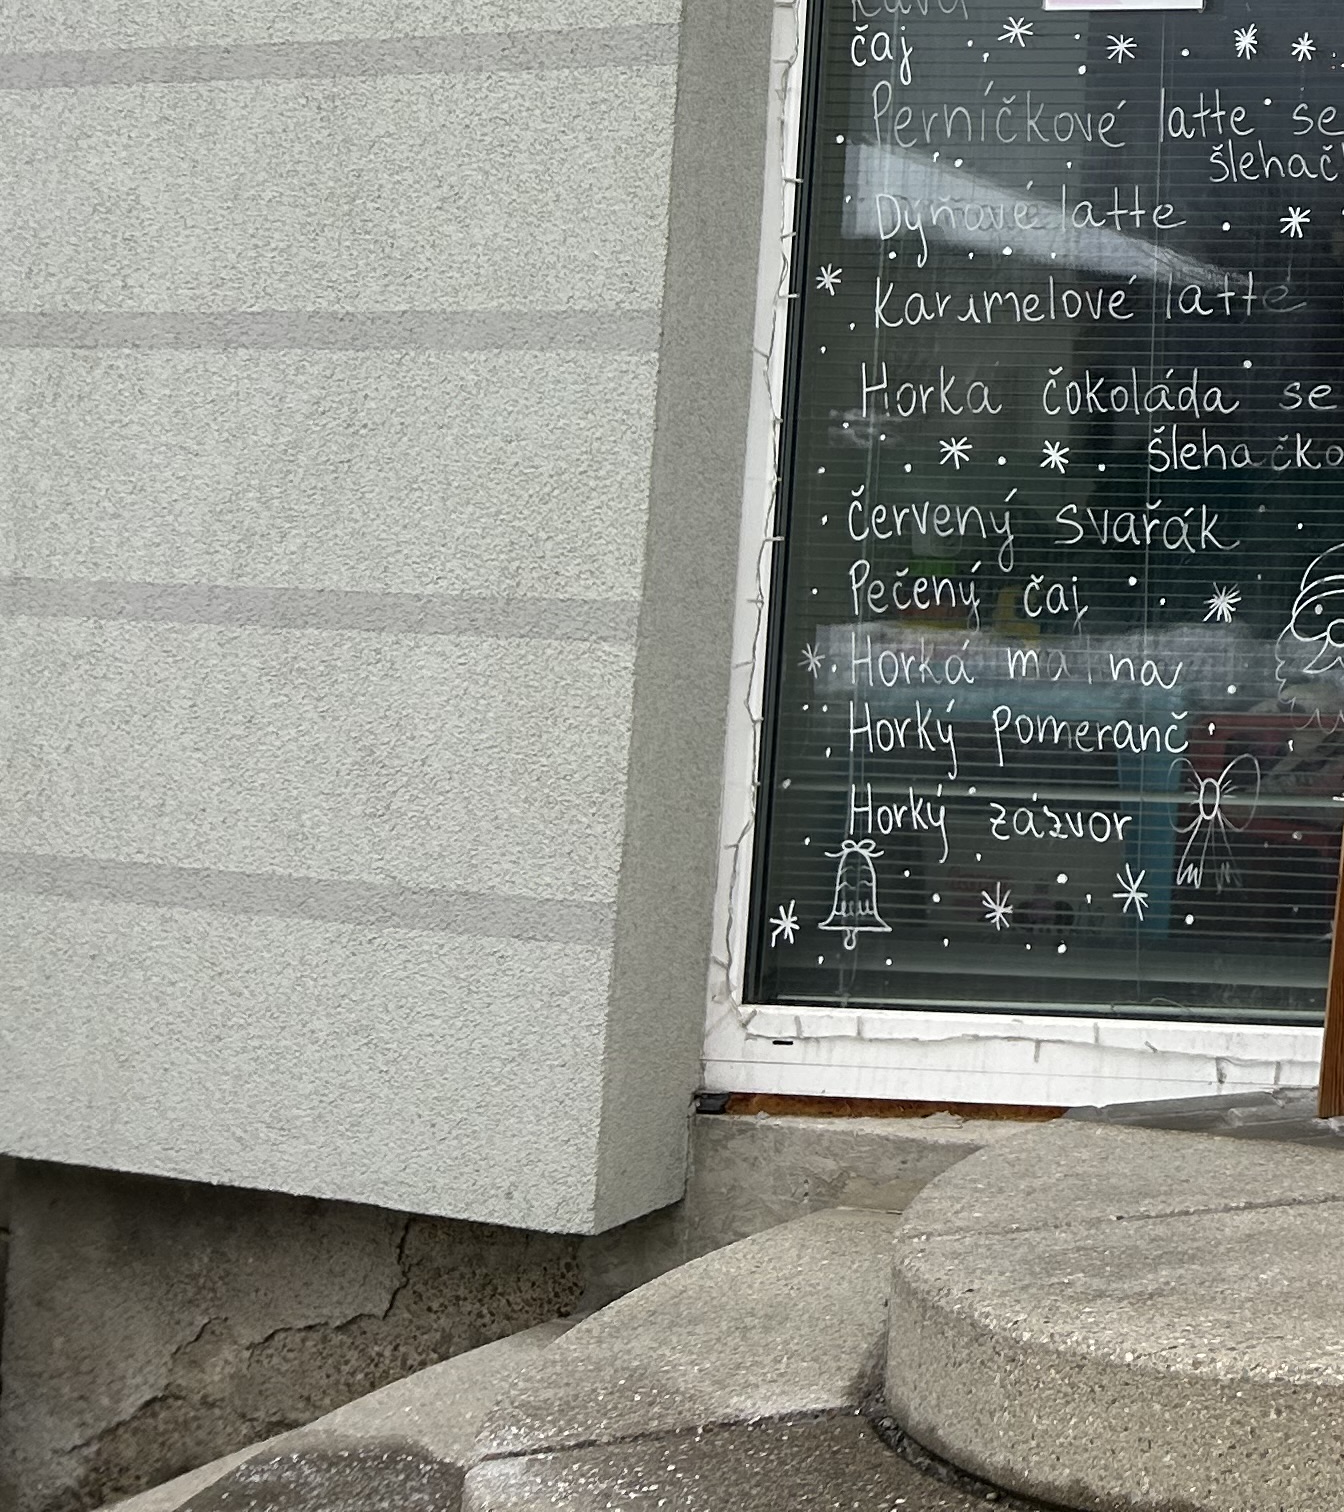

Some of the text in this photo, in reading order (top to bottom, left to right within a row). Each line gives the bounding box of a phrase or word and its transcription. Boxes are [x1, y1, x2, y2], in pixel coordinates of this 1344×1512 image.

[873, 81, 1129, 148] Perníčkové
[1160, 88, 1255, 142] latte
[876, 180, 1188, 268] Dýňové latte
[1166, 271, 1307, 319] latte
[1042, 367, 1240, 419] čokoláda
[1278, 381, 1338, 411] se
[849, 559, 983, 632] Pečený
[851, 632, 975, 687] Horká
[850, 698, 958, 780] Horký
[850, 783, 949, 863] Horký
